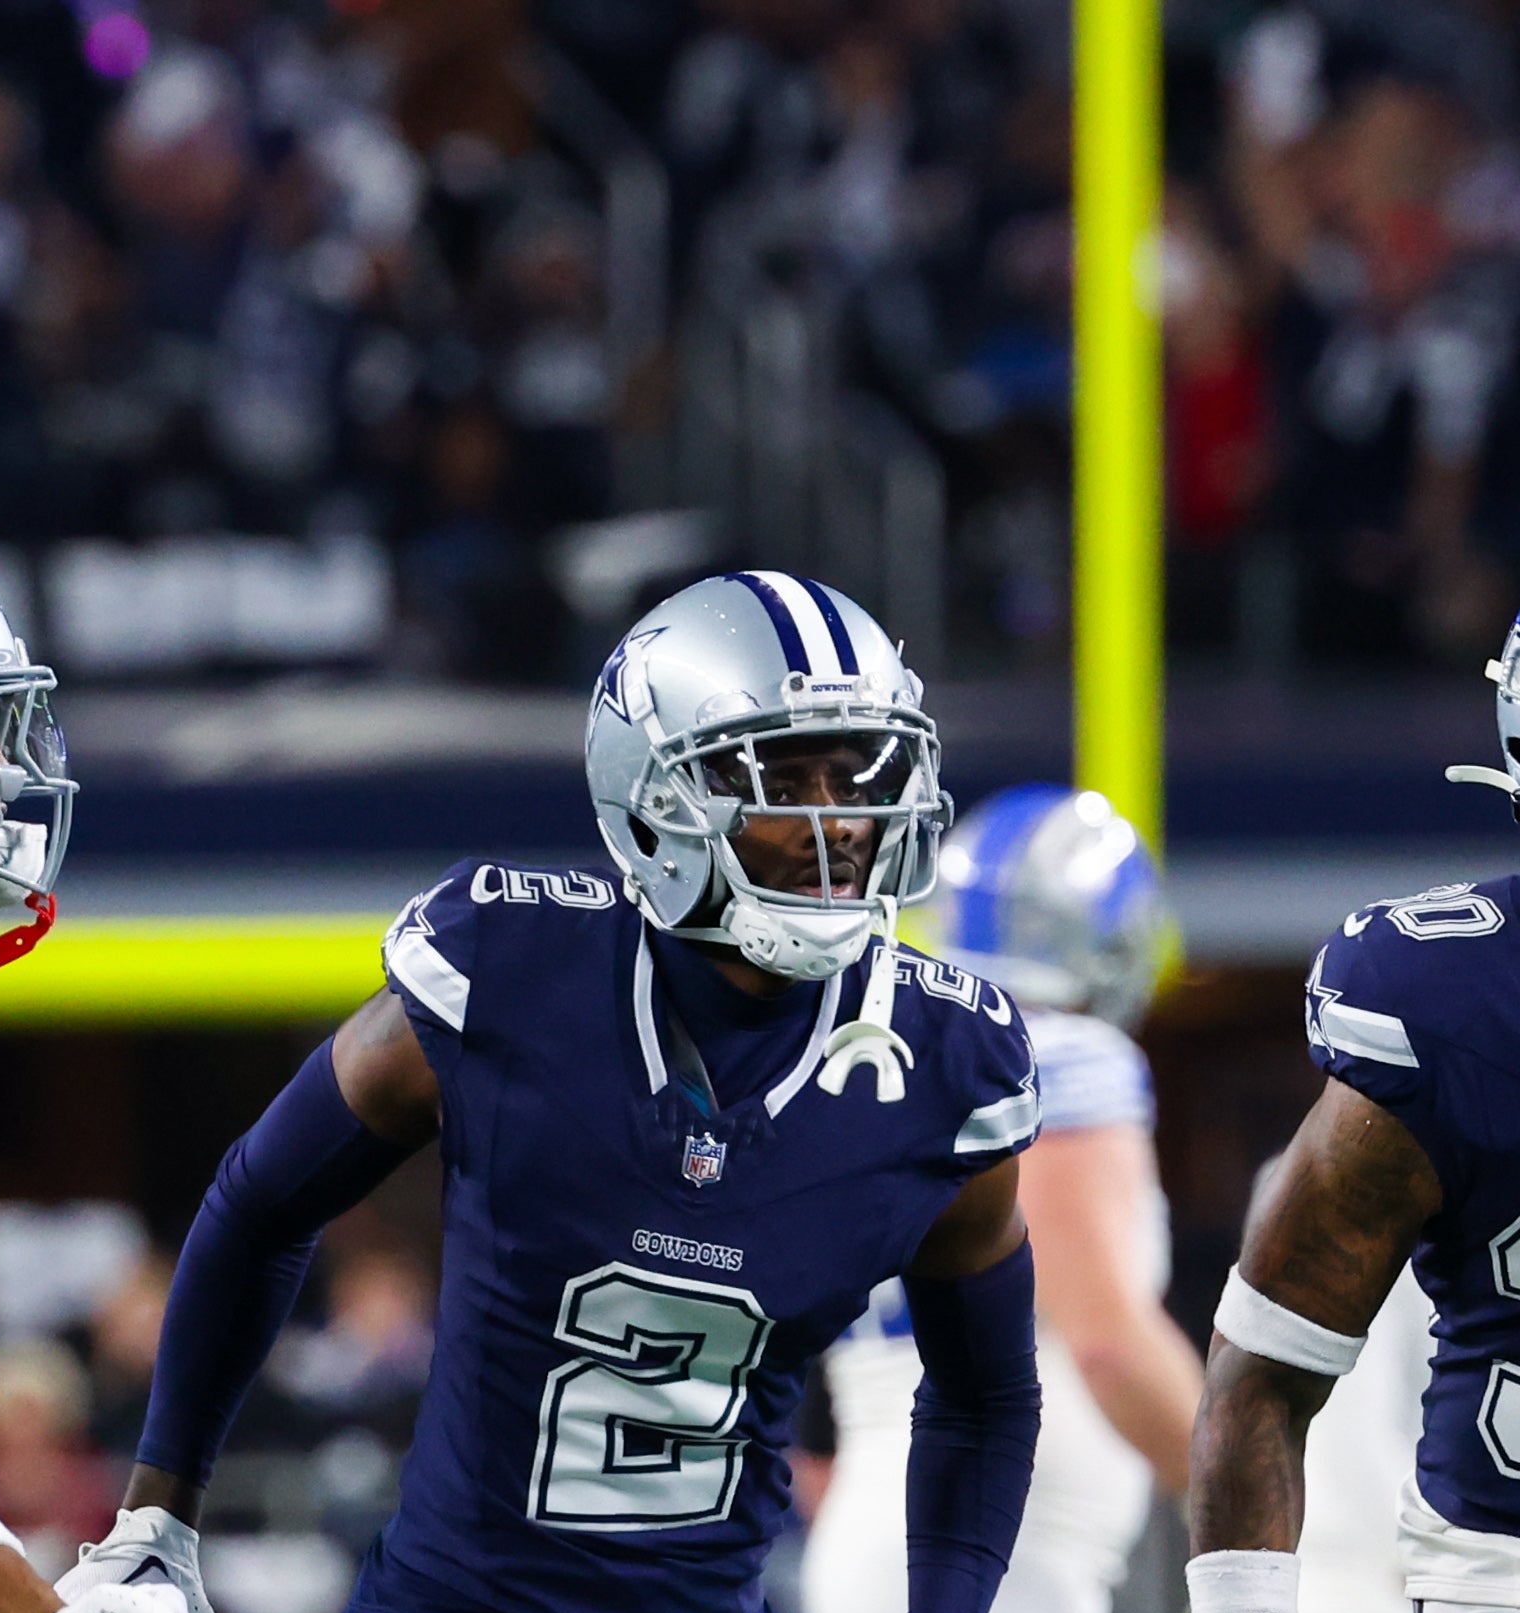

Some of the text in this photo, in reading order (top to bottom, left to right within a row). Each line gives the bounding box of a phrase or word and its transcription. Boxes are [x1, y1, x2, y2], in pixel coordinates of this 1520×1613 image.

[810, 683, 855, 693] COWBOYS
[632, 1228, 745, 1272] COWBOYS
[525, 1261, 774, 1533] 2
